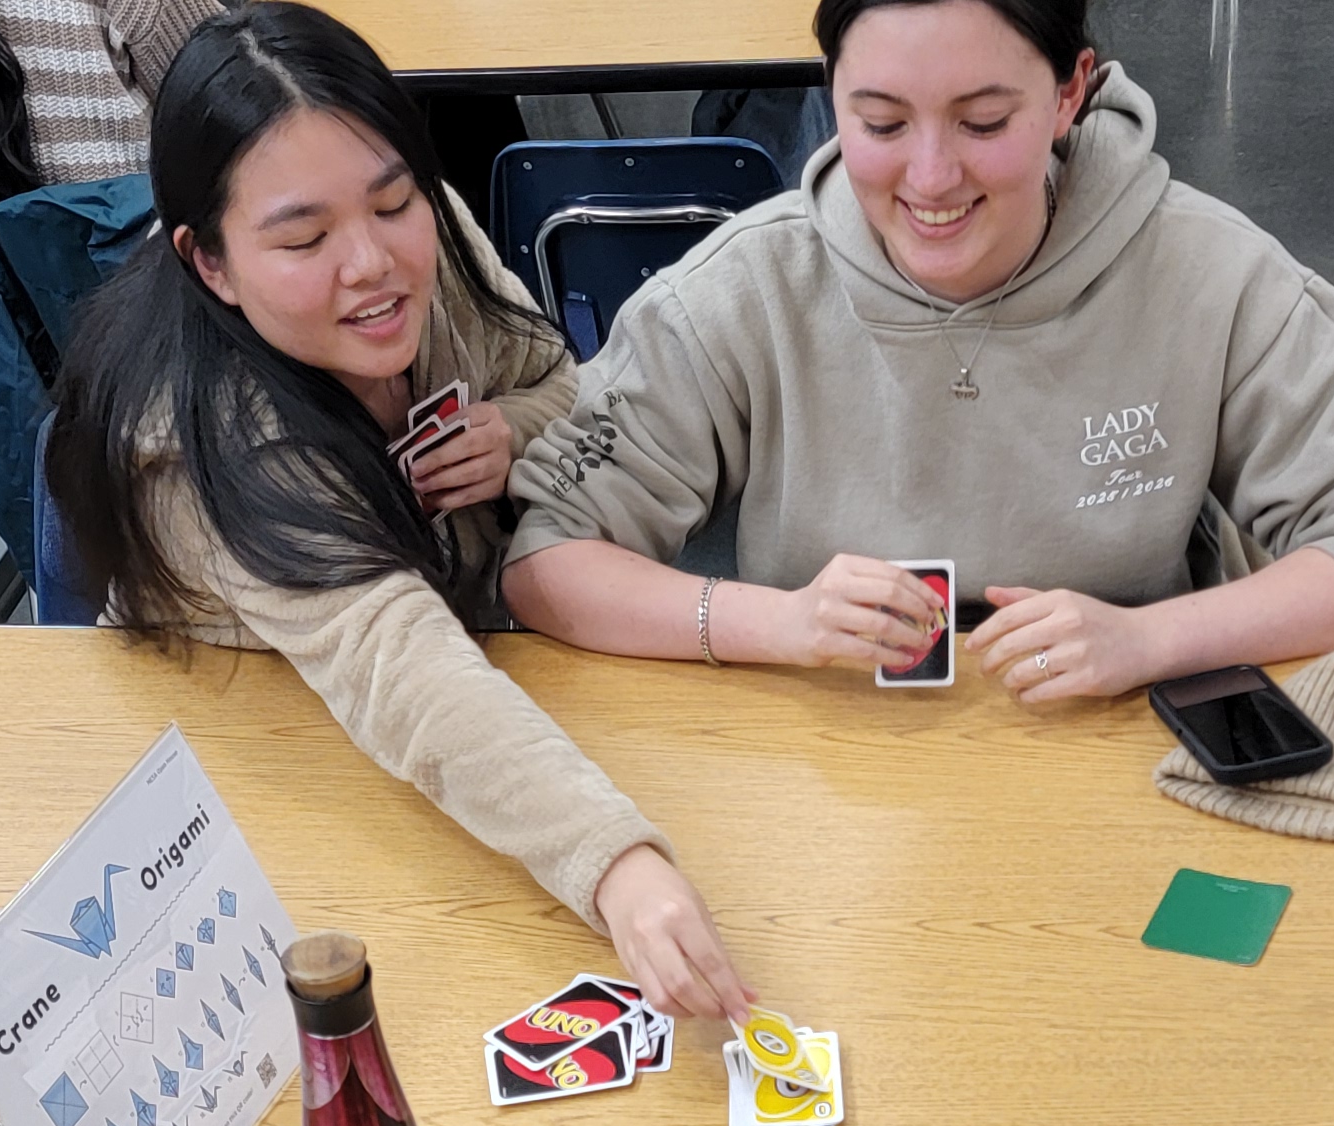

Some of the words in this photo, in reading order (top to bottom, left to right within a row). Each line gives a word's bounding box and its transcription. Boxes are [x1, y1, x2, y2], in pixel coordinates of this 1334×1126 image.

[1082, 401, 1160, 442] LADY
[1079, 428, 1169, 467] GAGA
[1104, 468, 1144, 487] Tour
[138, 805, 213, 893] Origami
[528, 1006, 601, 1039] UNO
[813, 1100, 832, 1119] 0
